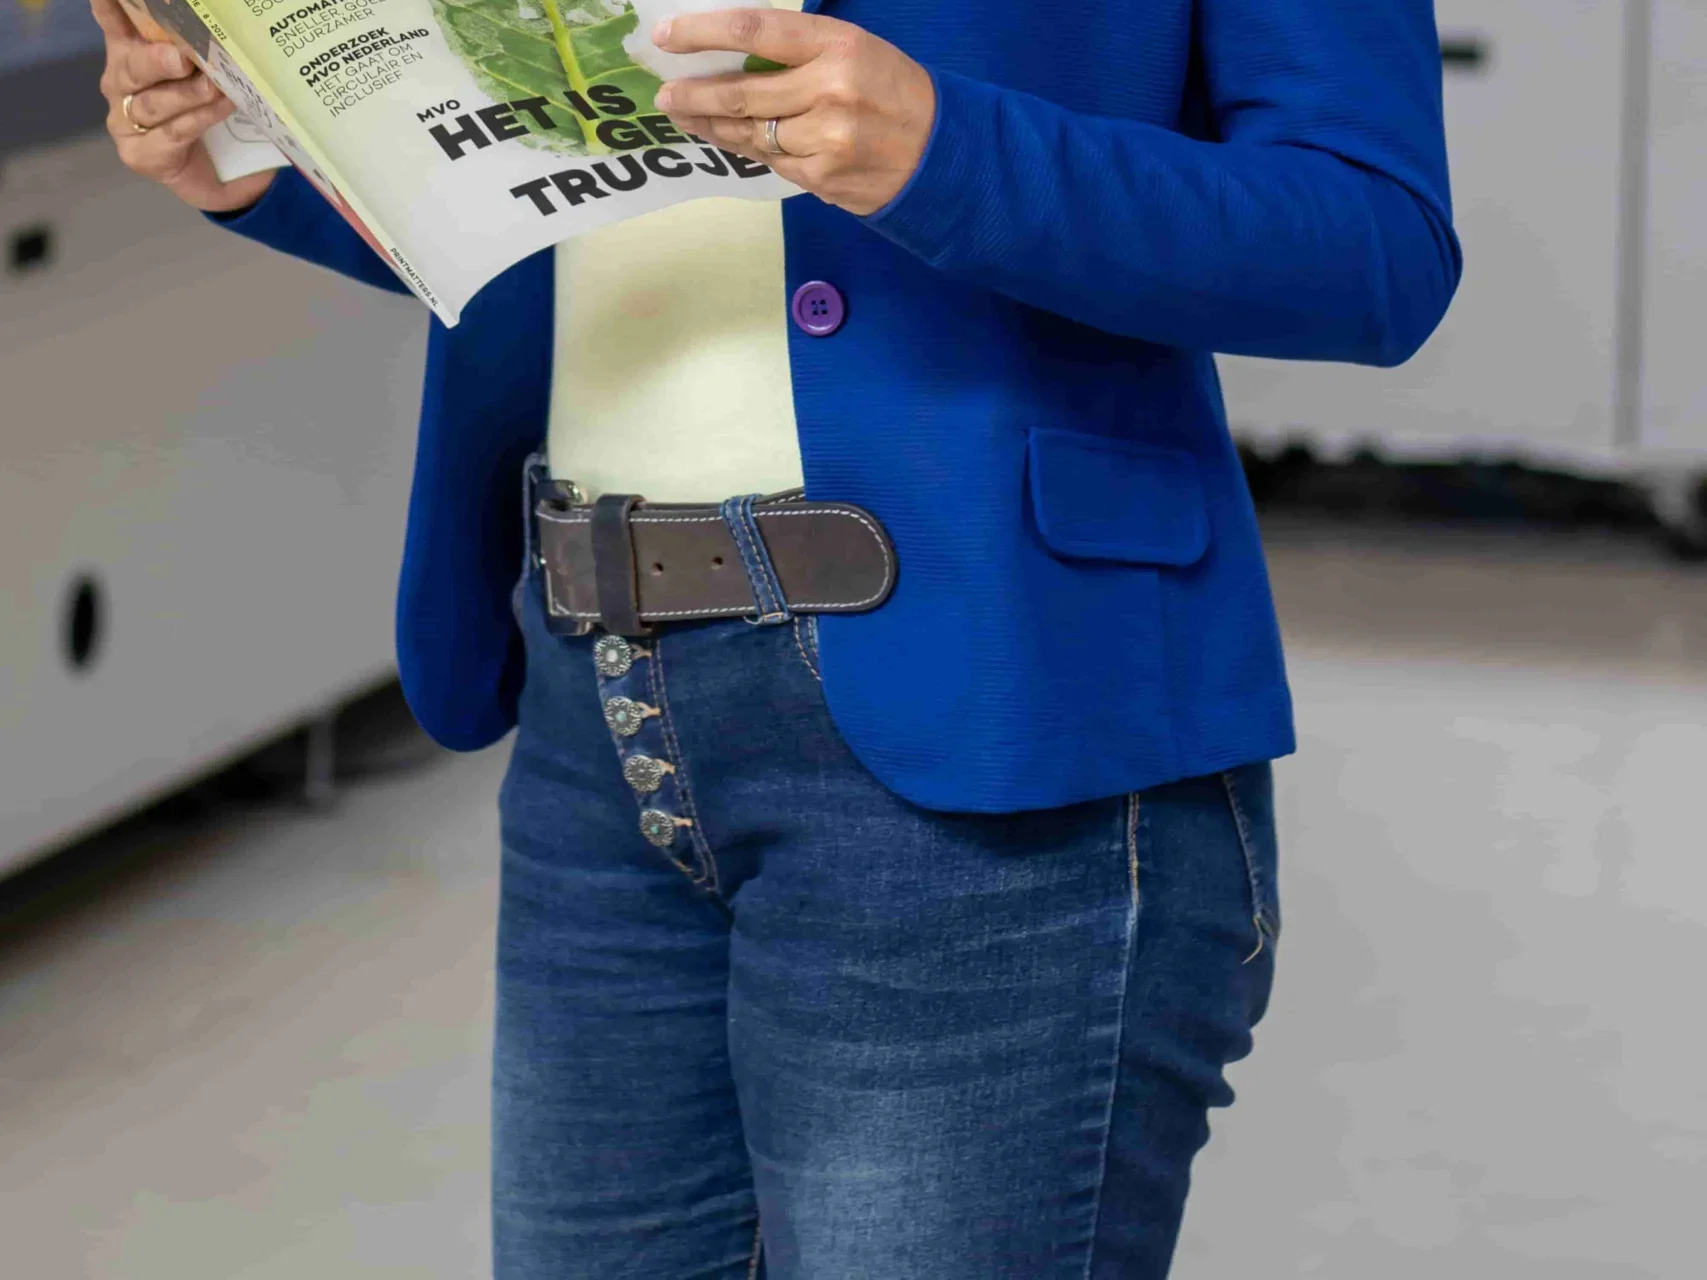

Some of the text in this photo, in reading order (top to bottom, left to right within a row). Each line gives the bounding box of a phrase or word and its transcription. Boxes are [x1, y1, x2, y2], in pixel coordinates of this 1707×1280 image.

[211, 23, 228, 41] 2022
[275, 8, 345, 47] SNELLER,
[283, 8, 376, 58] DUURZAMER
[299, 27, 390, 77] ONDERZOEK
[305, 28, 430, 88] MVO NEDERLAND
[314, 43, 414, 98] HET GAAT OM
[322, 51, 424, 108] CIRCULAIR EN
[329, 69, 403, 118] INCLUSIEF
[415, 98, 461, 124] MVO
[427, 83, 638, 161] HET IS
[509, 146, 772, 217] TRUCJE
[390, 247, 439, 307] PRINTMATTERS.NL
